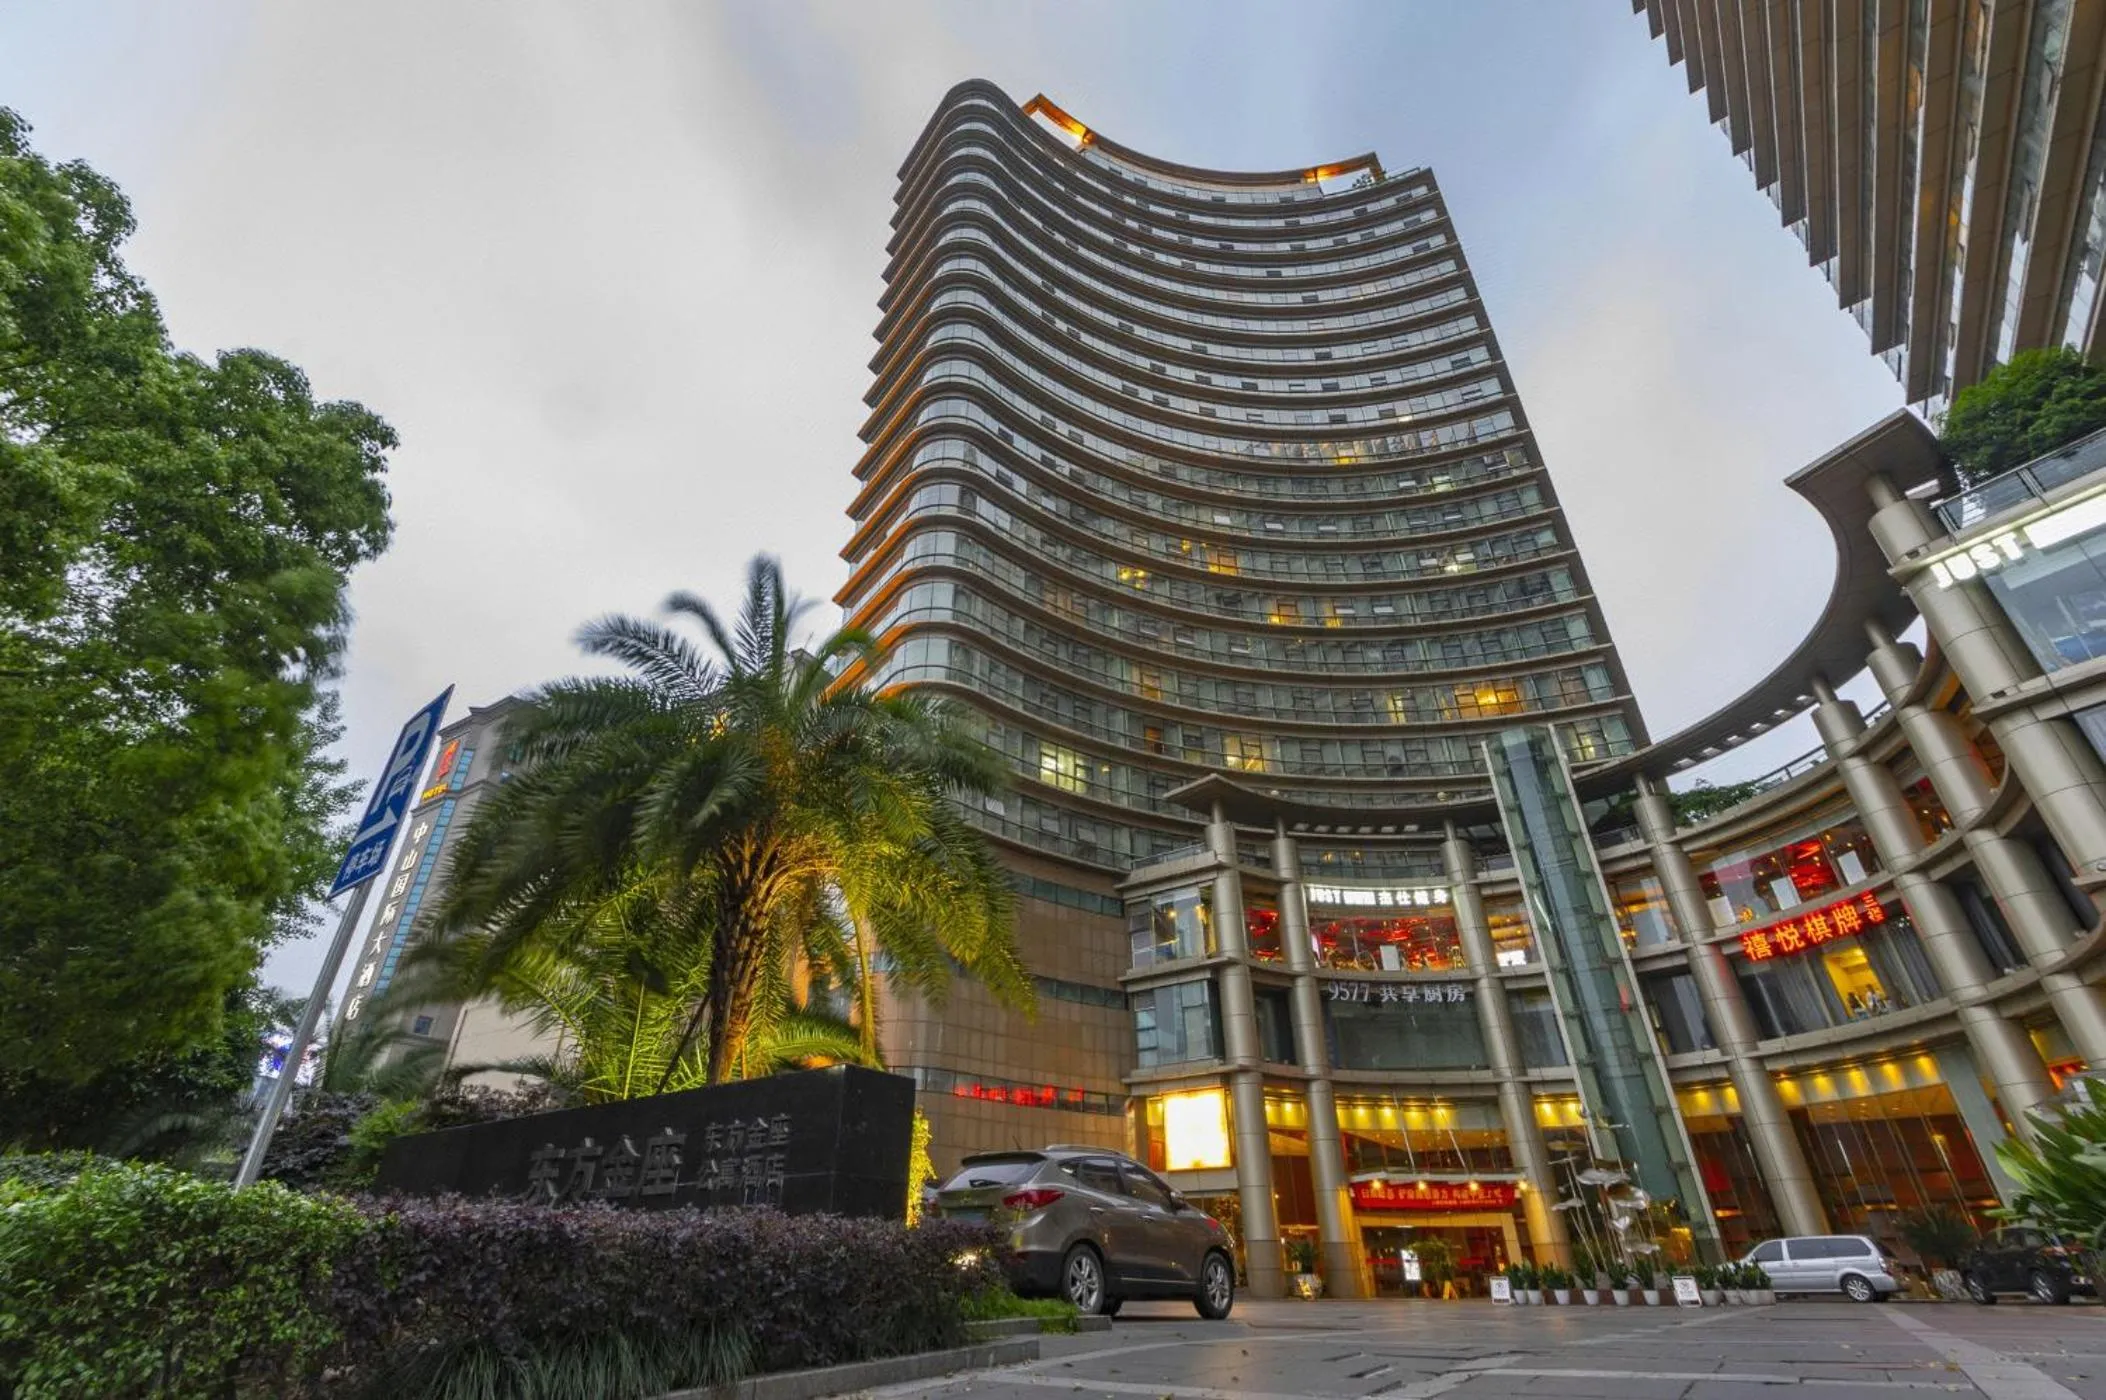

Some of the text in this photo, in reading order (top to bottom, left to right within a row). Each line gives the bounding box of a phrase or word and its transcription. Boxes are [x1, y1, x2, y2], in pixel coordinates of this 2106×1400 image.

[1930, 532, 2023, 588] JUST
[345, 821, 428, 1020] 中山国际大酒店
[1743, 904, 1862, 960] 禧悦棋牌
[1328, 982, 1370, 1001] 9577
[1380, 984, 1466, 1002] 共享厨房
[703, 1113, 792, 1150] 东方金座
[522, 1127, 687, 1205] 东方金座
